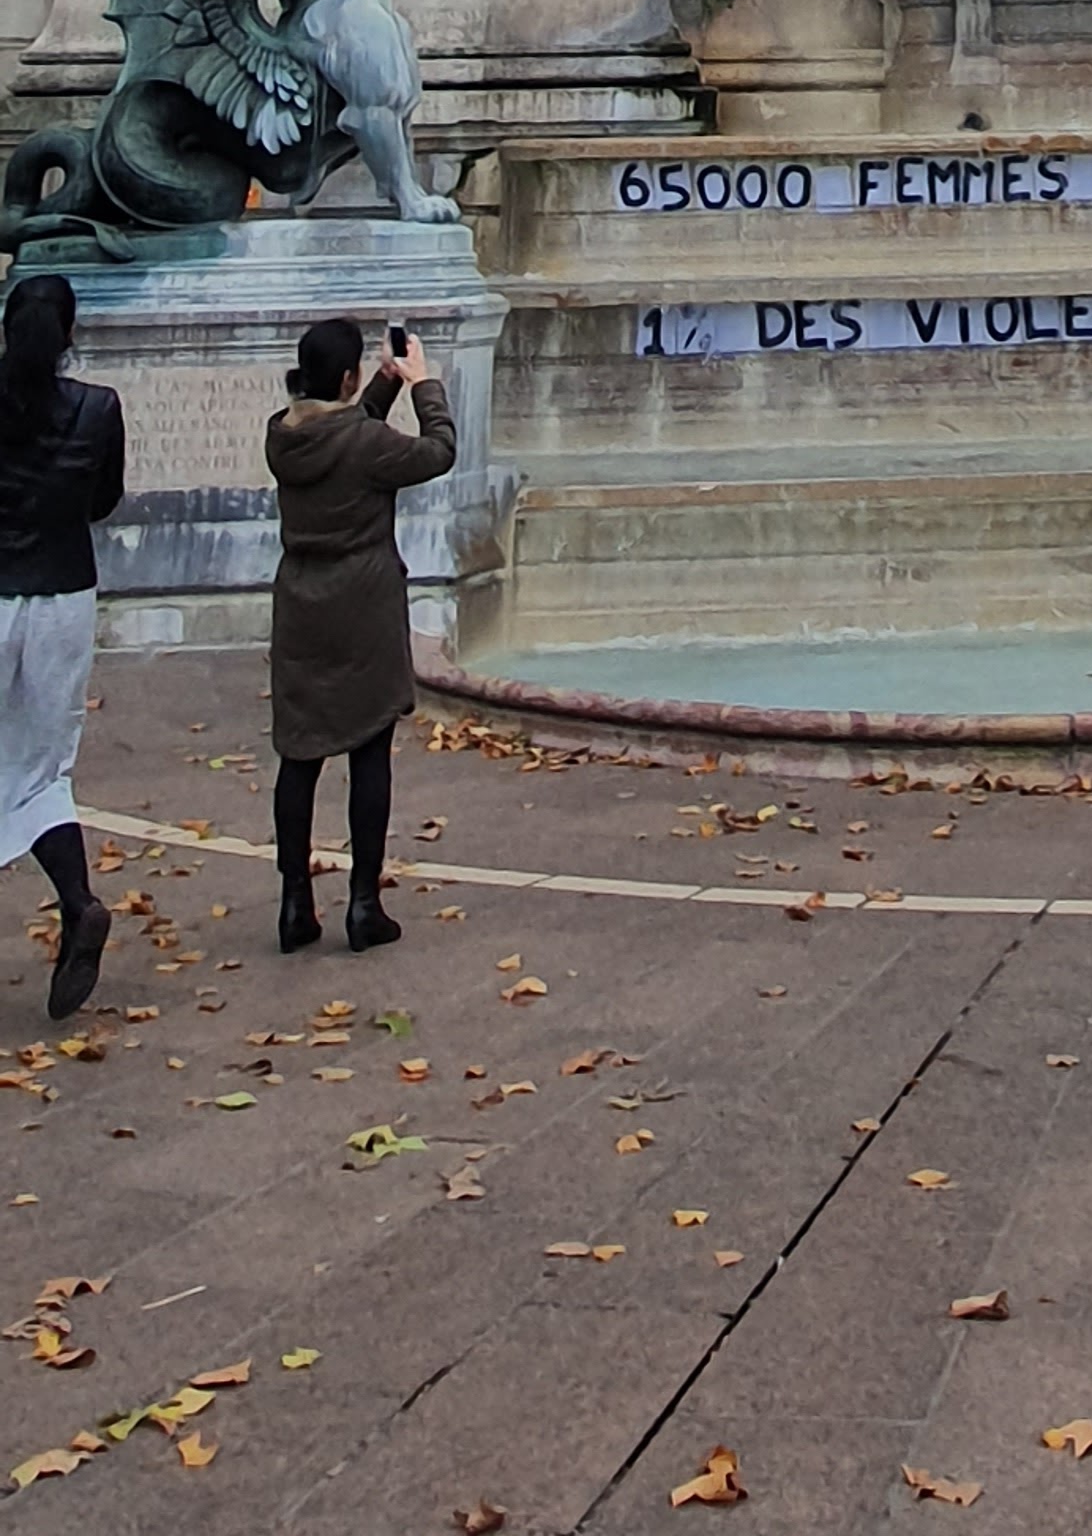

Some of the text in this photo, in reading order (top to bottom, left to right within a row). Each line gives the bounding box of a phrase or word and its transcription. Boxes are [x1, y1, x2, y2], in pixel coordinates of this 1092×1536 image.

[619, 163, 812, 211] 65000
[858, 154, 1069, 207] FEMMES
[755, 298, 864, 349] DES
